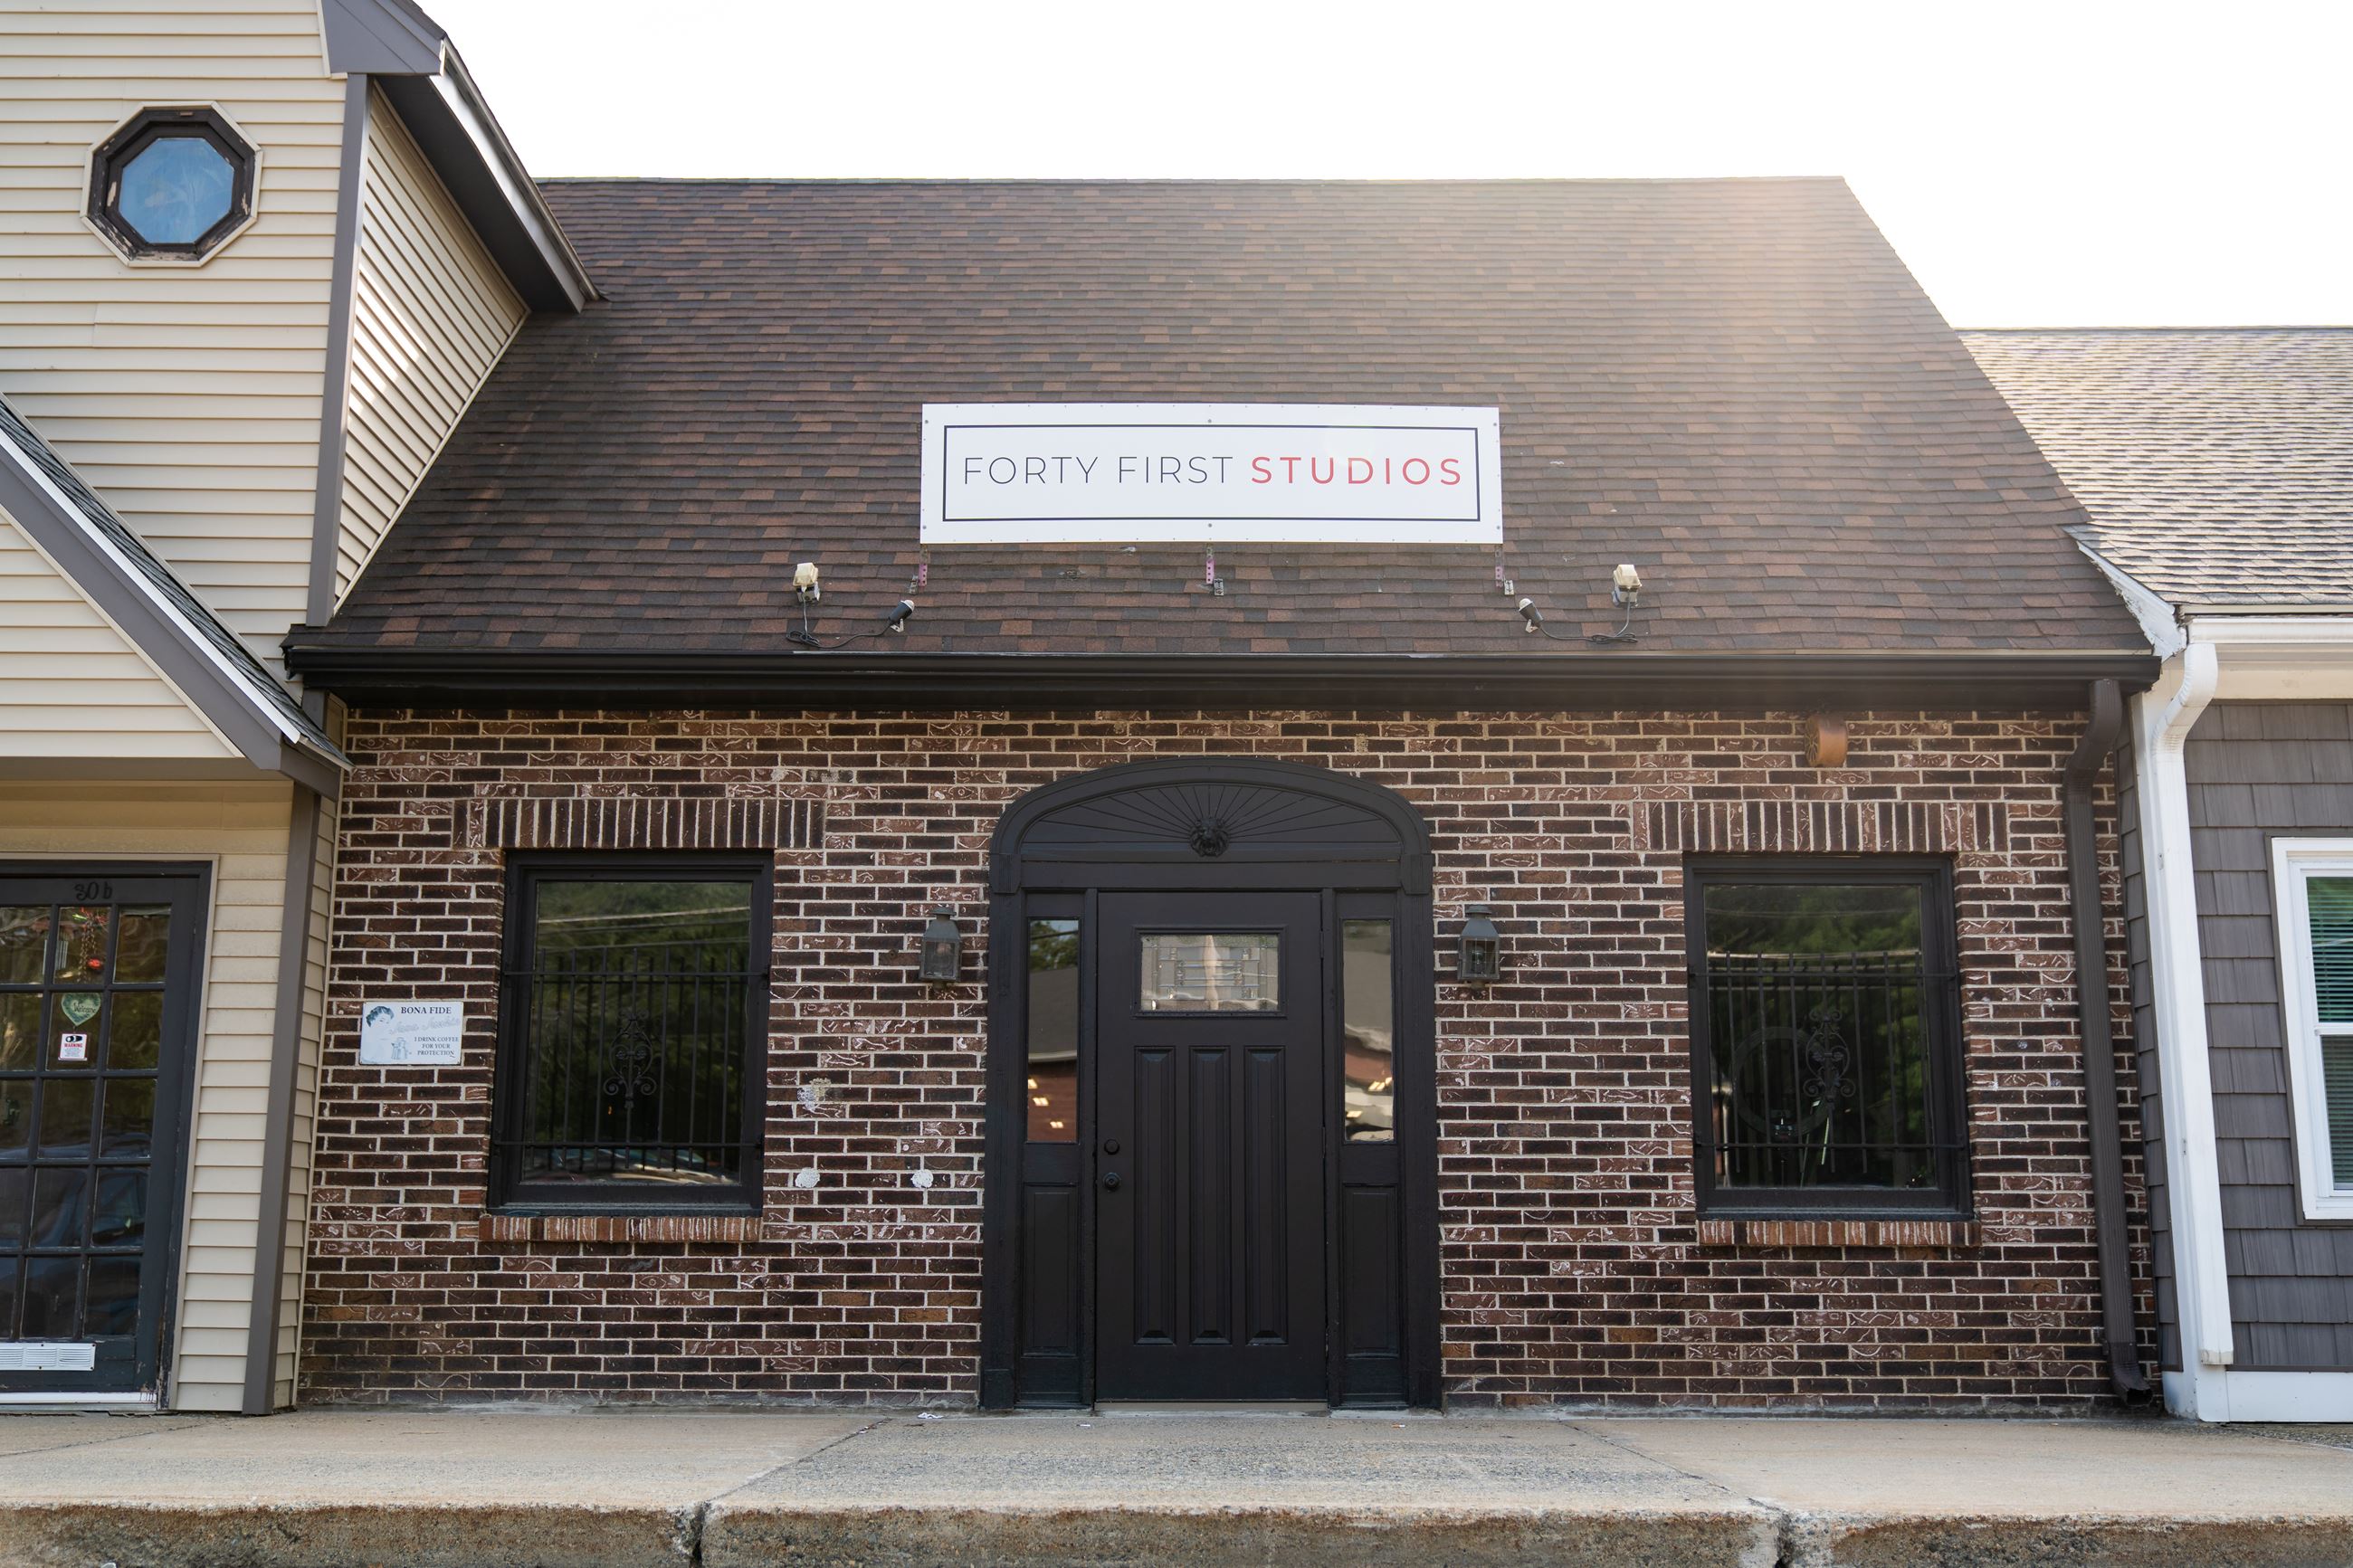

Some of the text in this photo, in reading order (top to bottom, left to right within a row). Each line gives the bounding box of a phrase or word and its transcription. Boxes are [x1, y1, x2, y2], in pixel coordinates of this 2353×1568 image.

[964, 455, 1462, 486] FORTY FIRST STUDIOS
[401, 1006, 452, 1014] BONA FIDE
